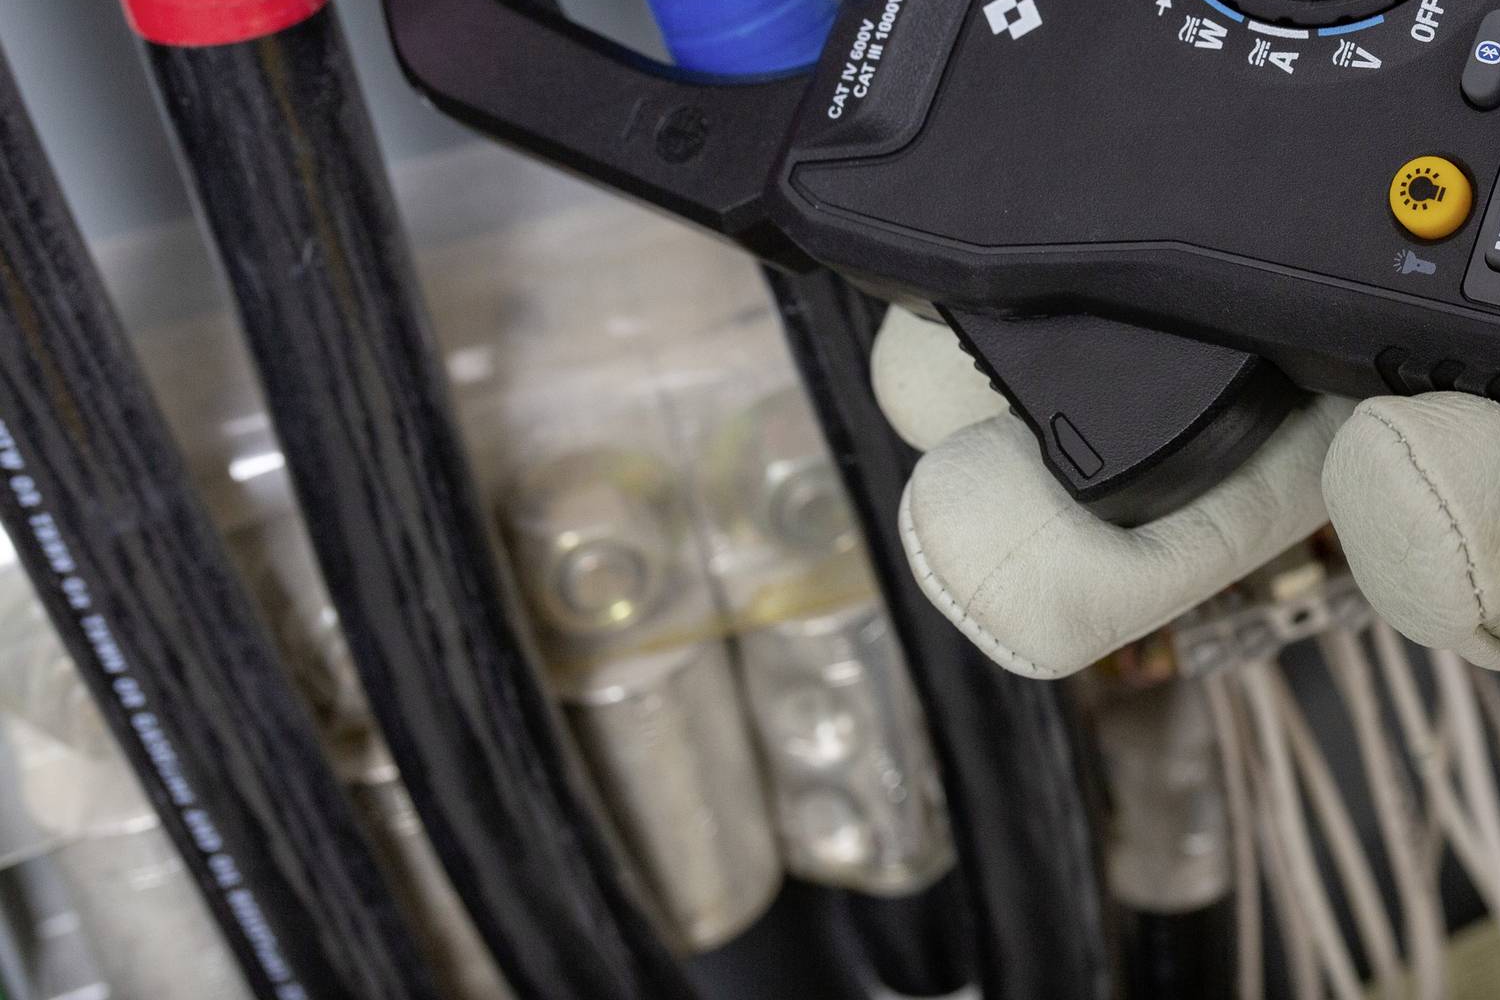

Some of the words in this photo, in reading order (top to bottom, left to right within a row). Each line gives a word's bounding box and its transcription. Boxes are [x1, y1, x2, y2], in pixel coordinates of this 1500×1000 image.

[1194, 17, 1228, 50] W
[827, 82, 850, 119] CAT
[841, 62, 858, 82] IV
[850, 18, 875, 61] 600V
[853, 62, 876, 98] CAT
[866, 43, 884, 60] III
[1268, 51, 1300, 75] A
[1351, 46, 1383, 69] V
